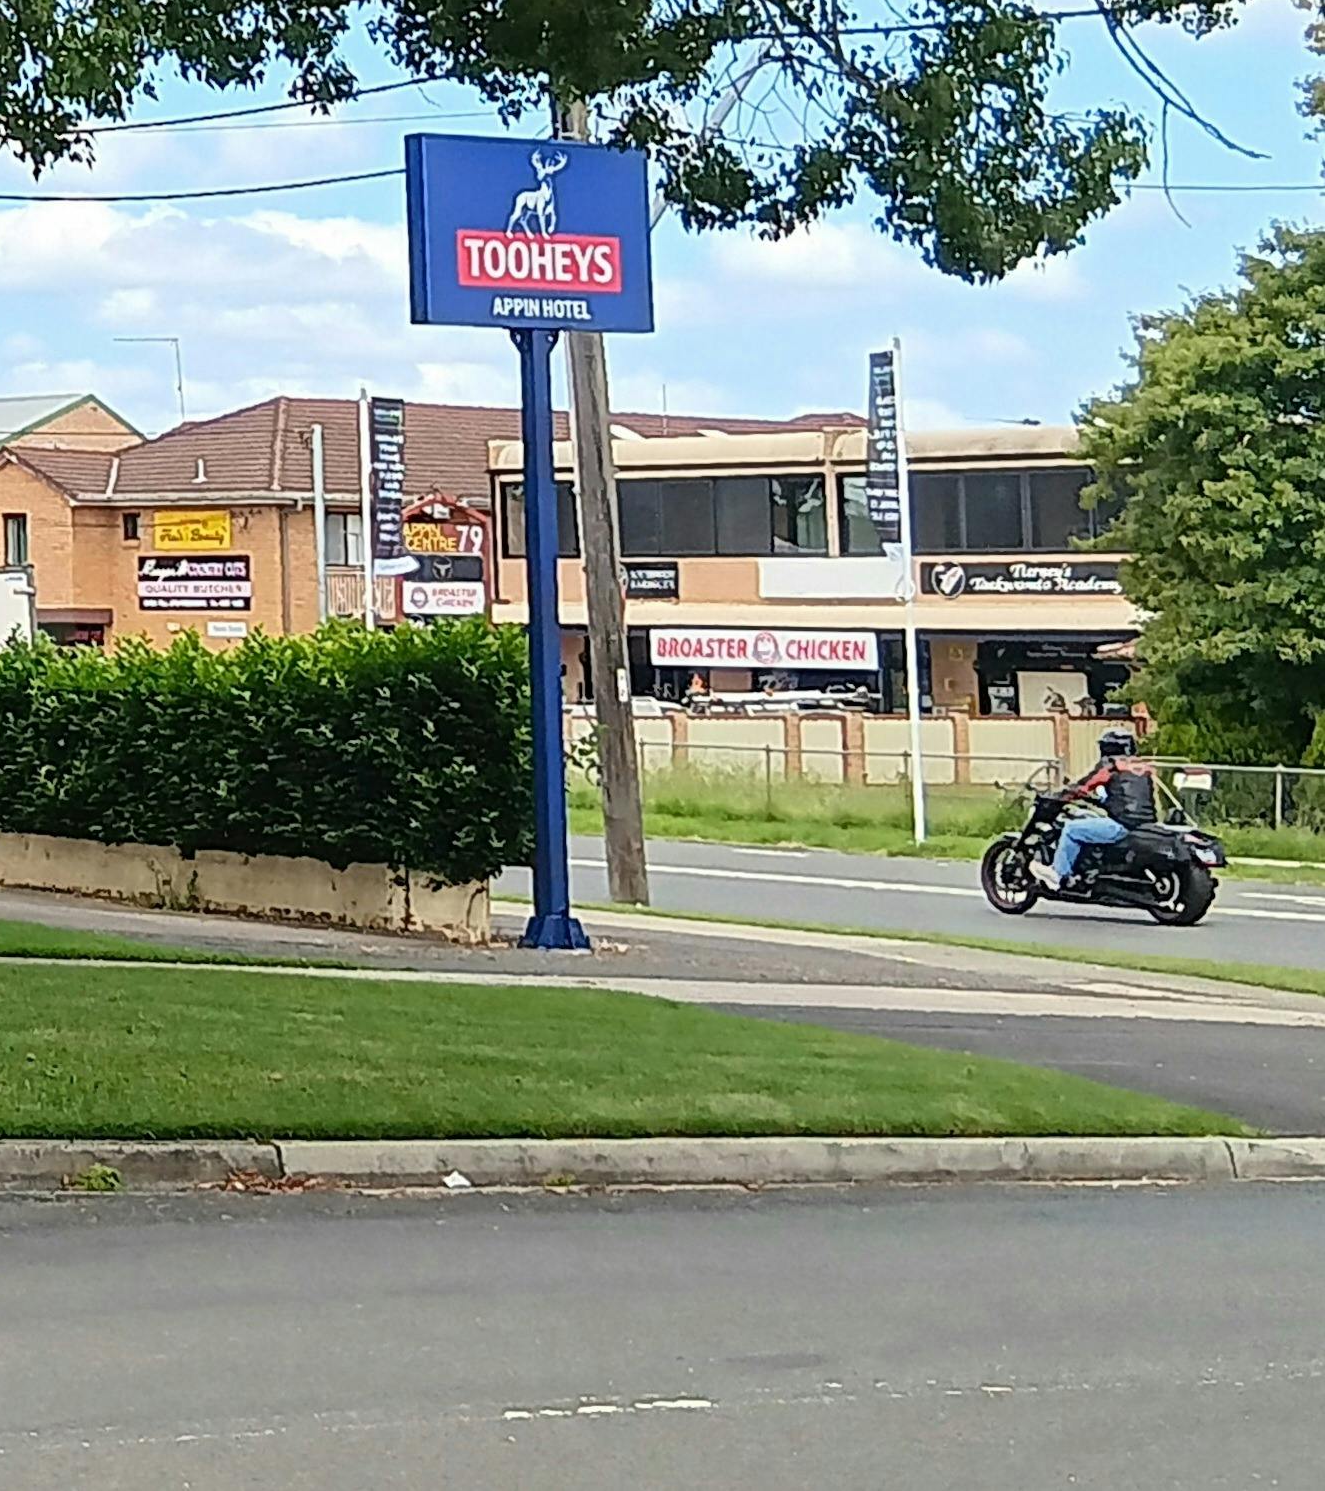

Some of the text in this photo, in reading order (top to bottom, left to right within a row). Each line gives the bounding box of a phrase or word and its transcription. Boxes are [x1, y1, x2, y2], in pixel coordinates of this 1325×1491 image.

[463, 238, 614, 284] TOOHEYS
[493, 296, 592, 320] APPIN HOTEL
[403, 523, 484, 554] APPIN 79
[404, 536, 458, 552] CENTRE
[657, 636, 867, 661] BROASTER CHICKEN
